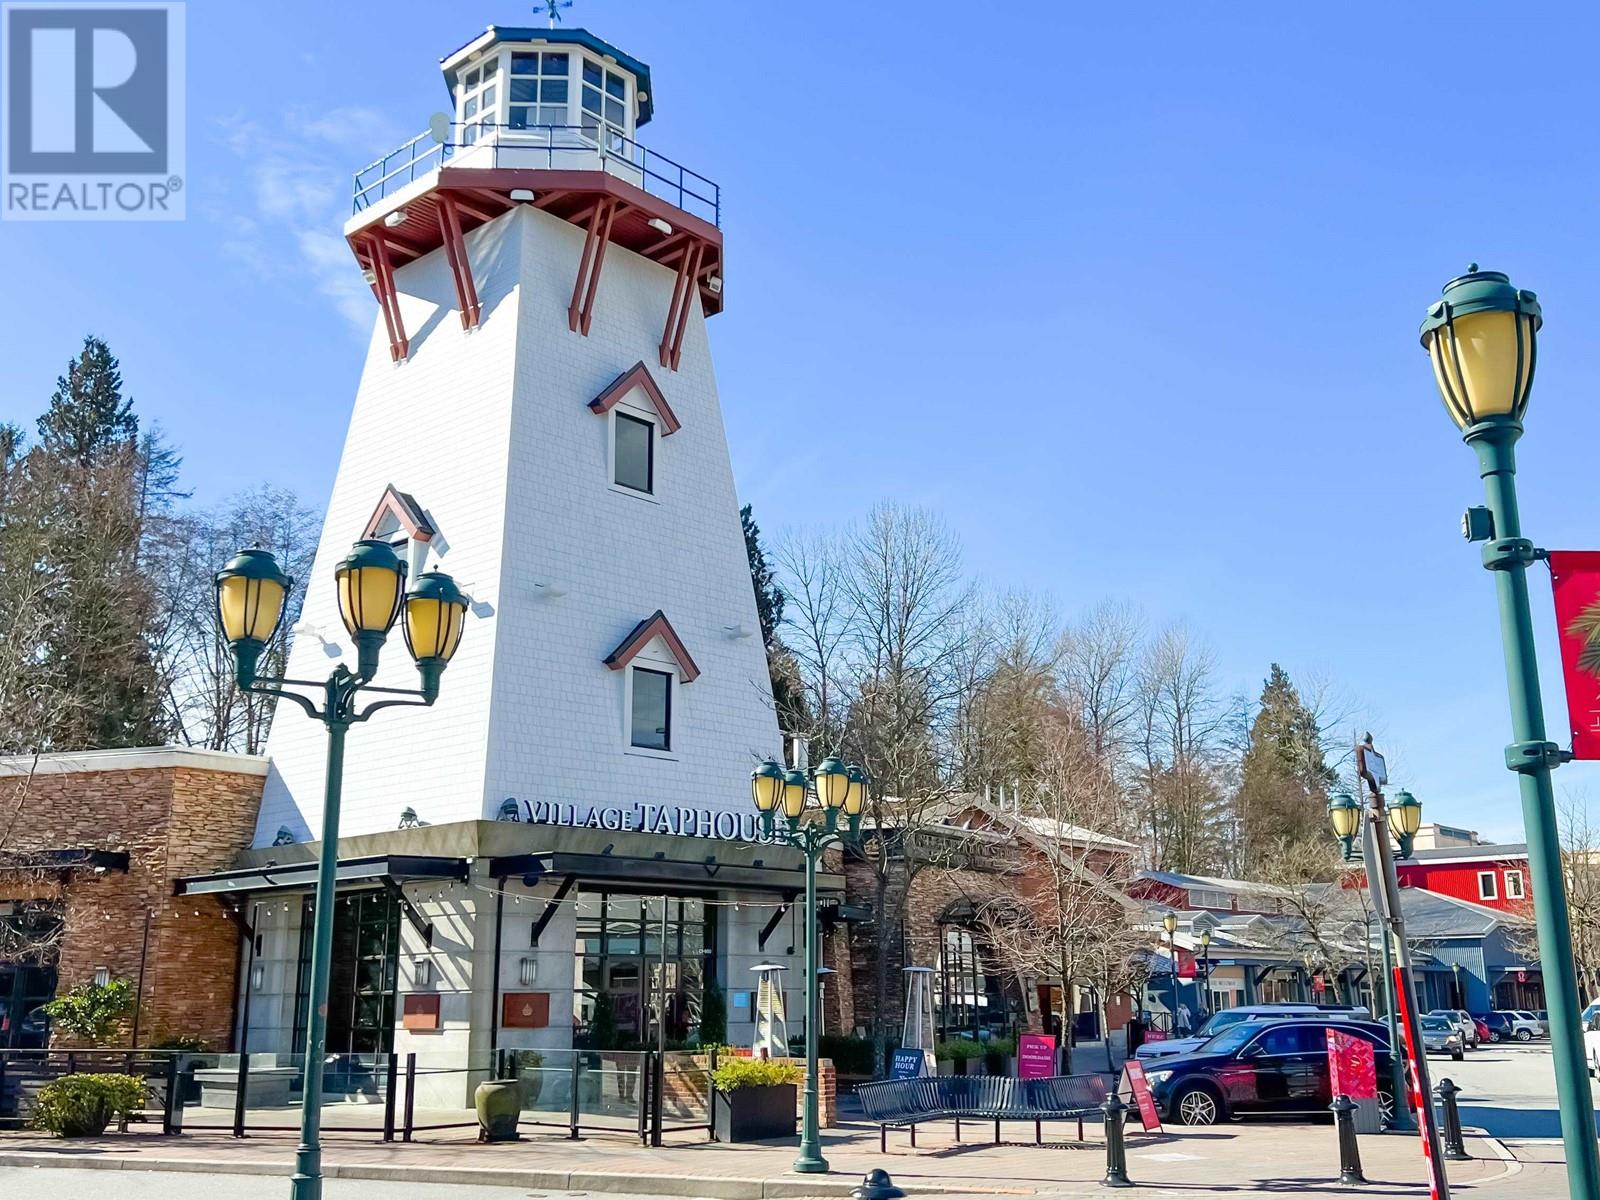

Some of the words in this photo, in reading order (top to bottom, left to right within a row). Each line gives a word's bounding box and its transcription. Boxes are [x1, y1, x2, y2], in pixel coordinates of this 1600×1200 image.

[526, 799, 633, 832] VILLAGE
[895, 1055, 918, 1063] HAPPY
[894, 1062, 915, 1070] HOUR
